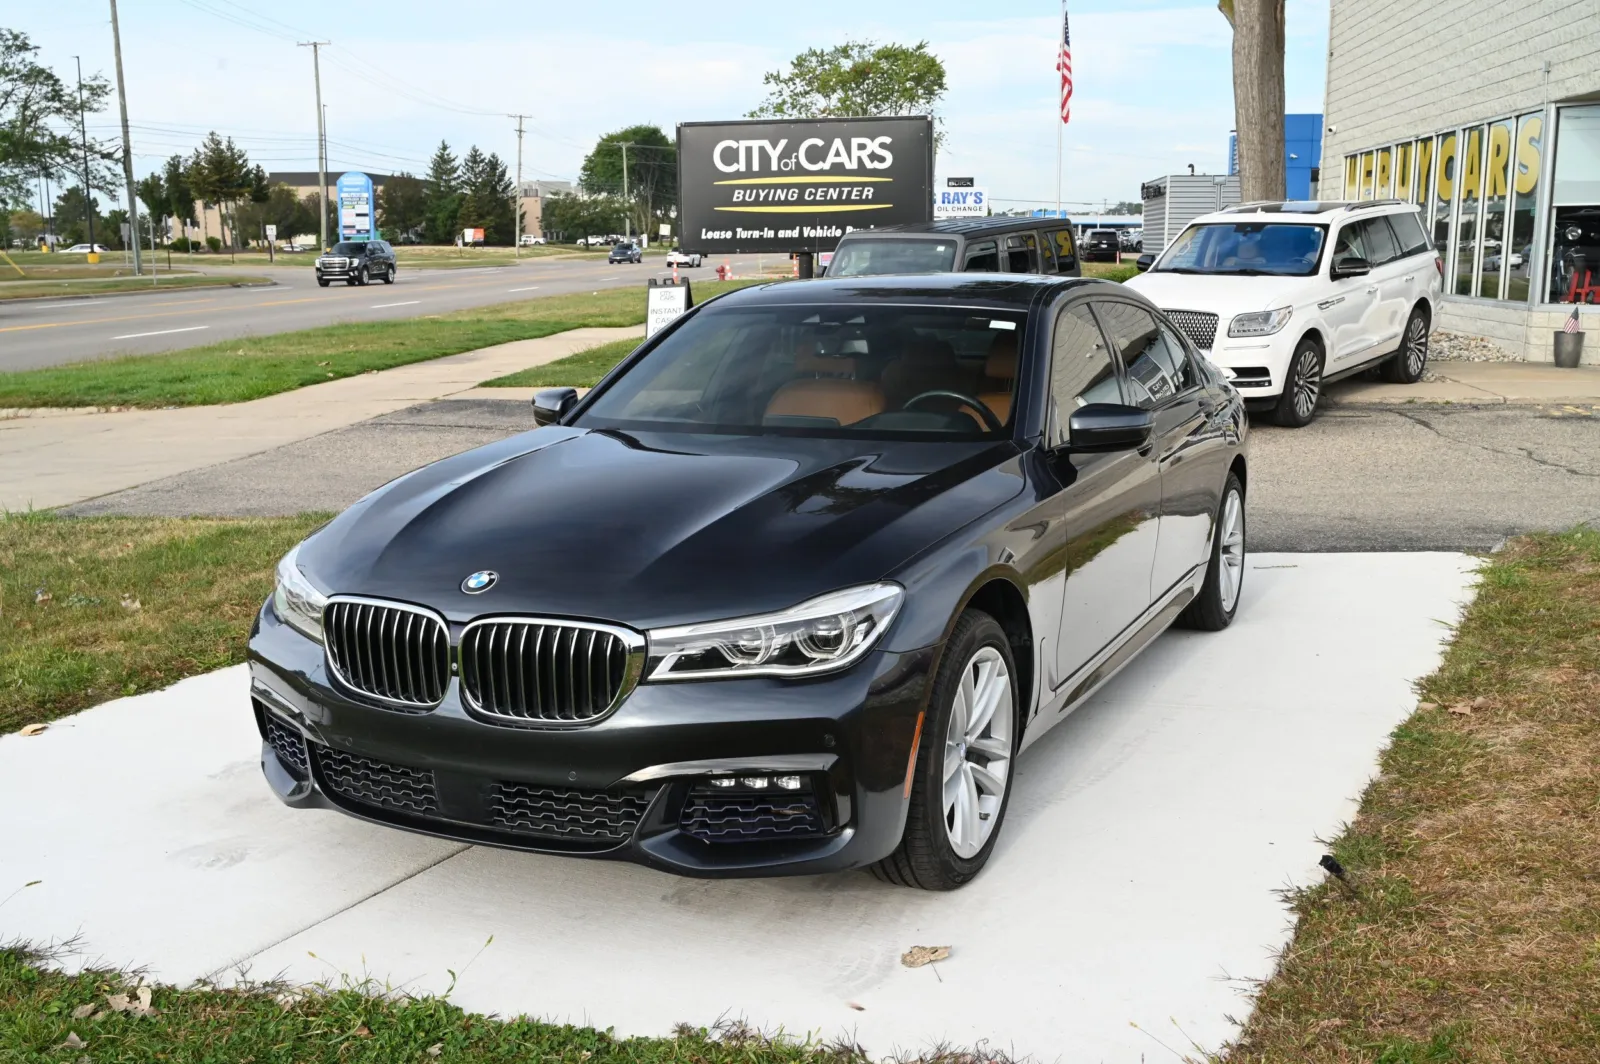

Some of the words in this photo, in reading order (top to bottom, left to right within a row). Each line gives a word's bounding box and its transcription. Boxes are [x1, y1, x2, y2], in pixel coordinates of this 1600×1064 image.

[713, 139, 788, 173] CITY
[780, 153, 797, 171] of
[798, 136, 893, 170] CARS
[1378, 141, 1434, 203] BUY
[1437, 117, 1543, 201] CARS
[732, 188, 799, 202] BUYING
[804, 187, 874, 200] CENTER
[941, 191, 983, 205] RAY'S
[701, 228, 732, 240] Lease
[736, 227, 775, 239] Turn-In
[777, 226, 800, 238] and
[802, 225, 842, 238] Vehicle
